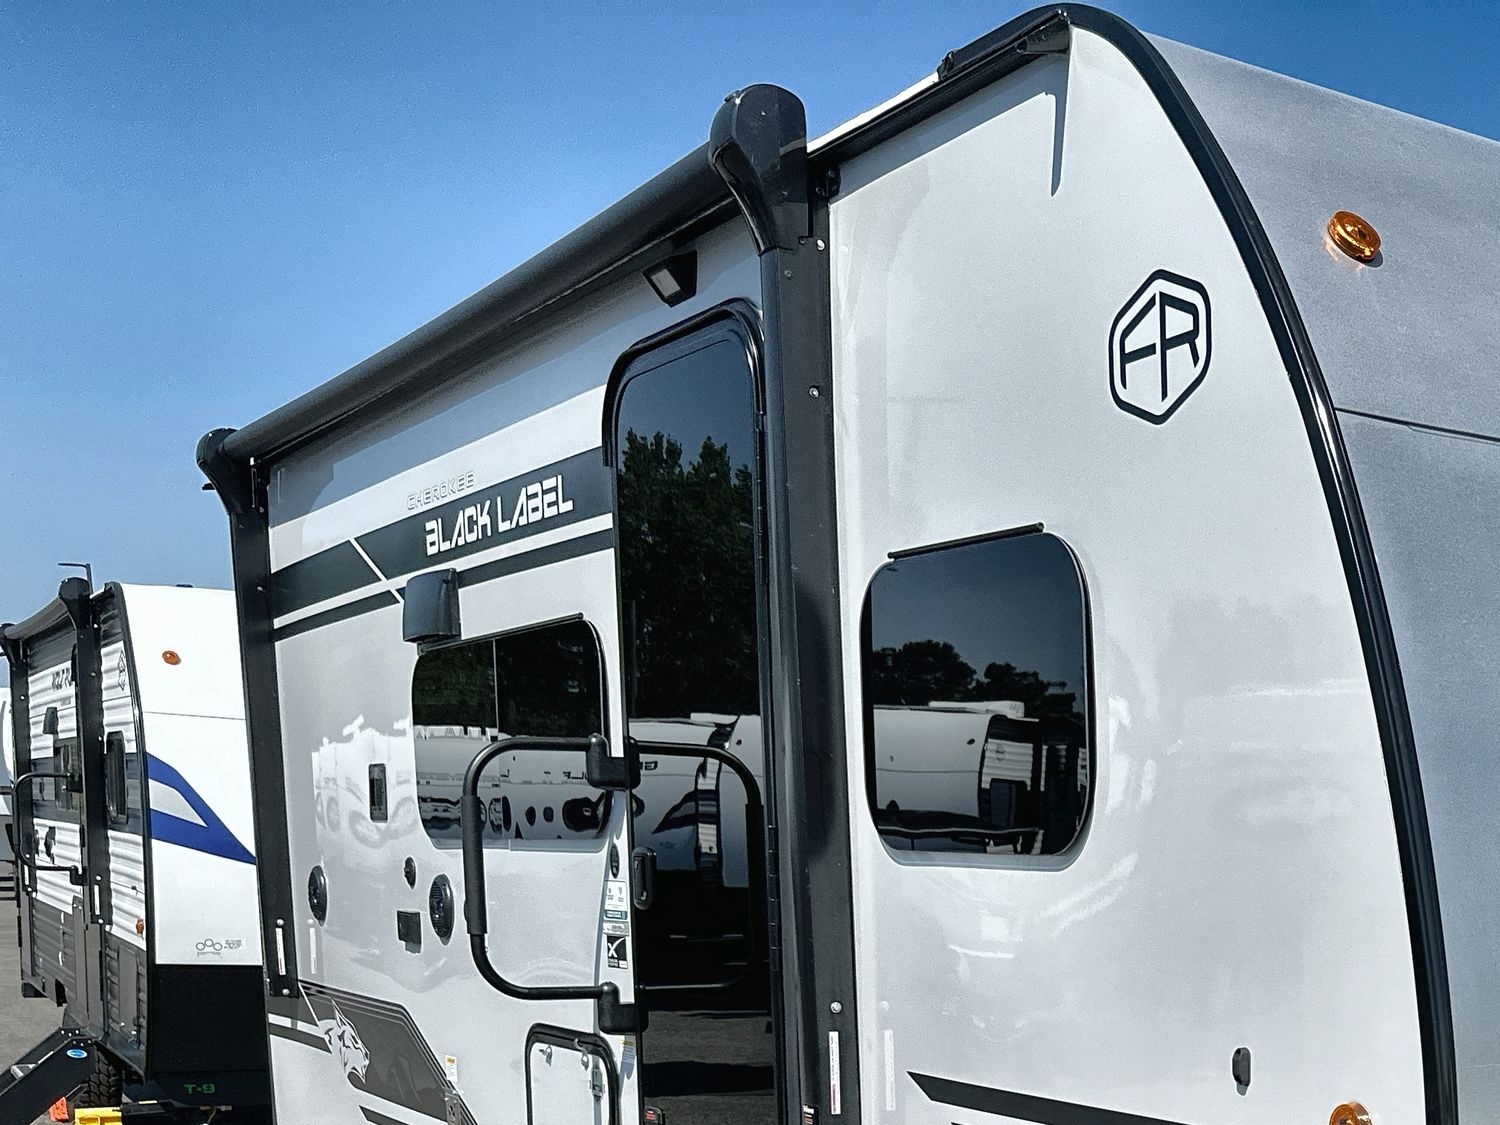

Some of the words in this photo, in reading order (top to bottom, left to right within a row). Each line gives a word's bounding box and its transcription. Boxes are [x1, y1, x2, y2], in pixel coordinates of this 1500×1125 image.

[406, 471, 476, 511] CHEROKEE
[424, 499, 492, 557] BLACK
[497, 474, 574, 533] LABEL
[183, 1083, 216, 1095] T-9
